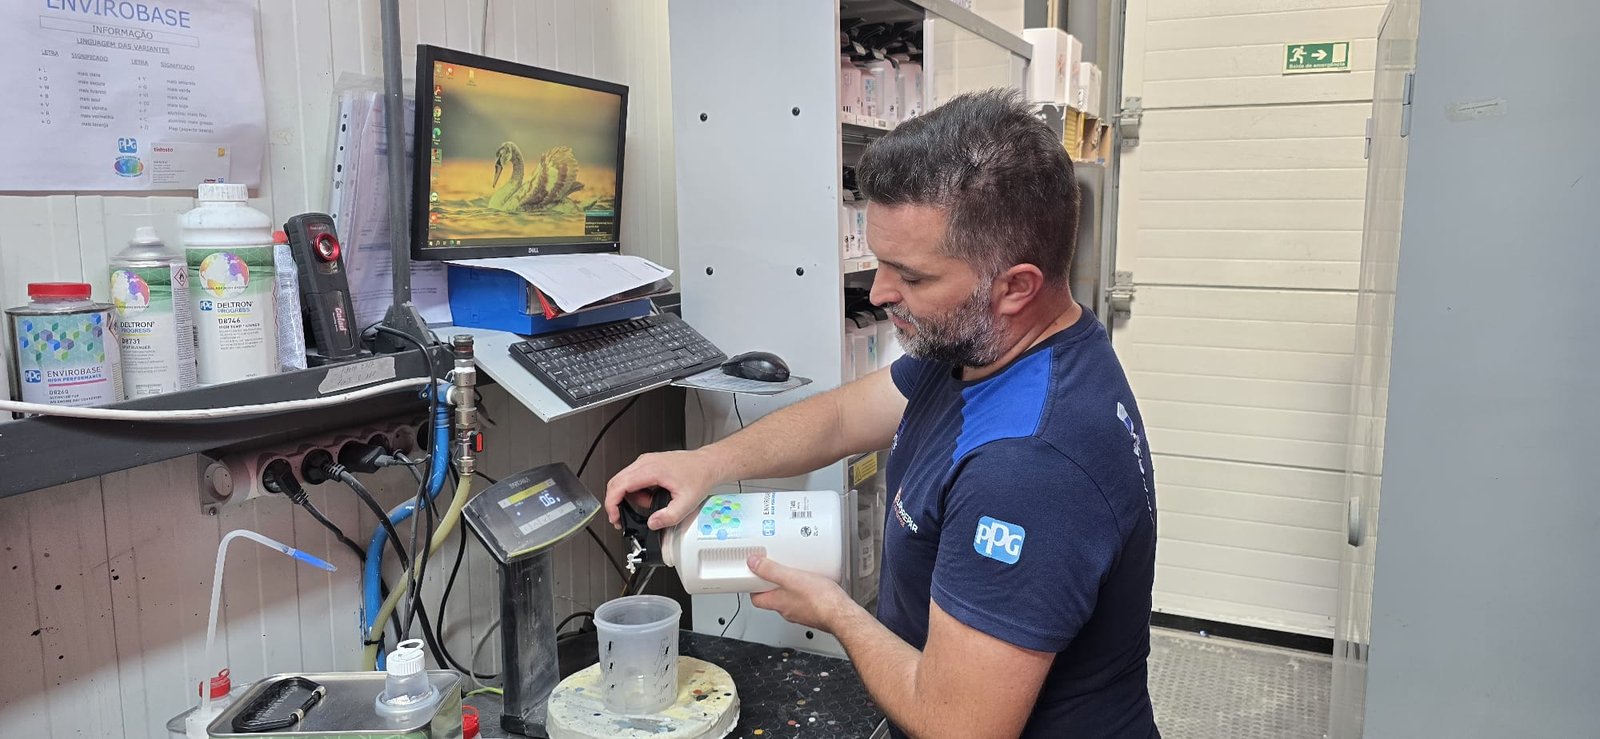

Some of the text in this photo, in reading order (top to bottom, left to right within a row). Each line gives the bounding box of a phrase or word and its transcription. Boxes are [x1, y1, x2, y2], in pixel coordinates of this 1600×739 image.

[47, 0, 191, 29] ENVIROBASE
[92, 25, 153, 40] INFORMAÇÃO
[77, 37, 170, 54] LINGUAGEM DAS VARIANTES
[72, 53, 108, 62] SIGNIFICADO
[160, 62, 195, 70] SIGNIFICADO
[118, 138, 137, 152] PPG
[25, 370, 41, 382] PPG
[48, 366, 101, 378] ENVIROBASE
[976, 522, 1022, 556] PPG
